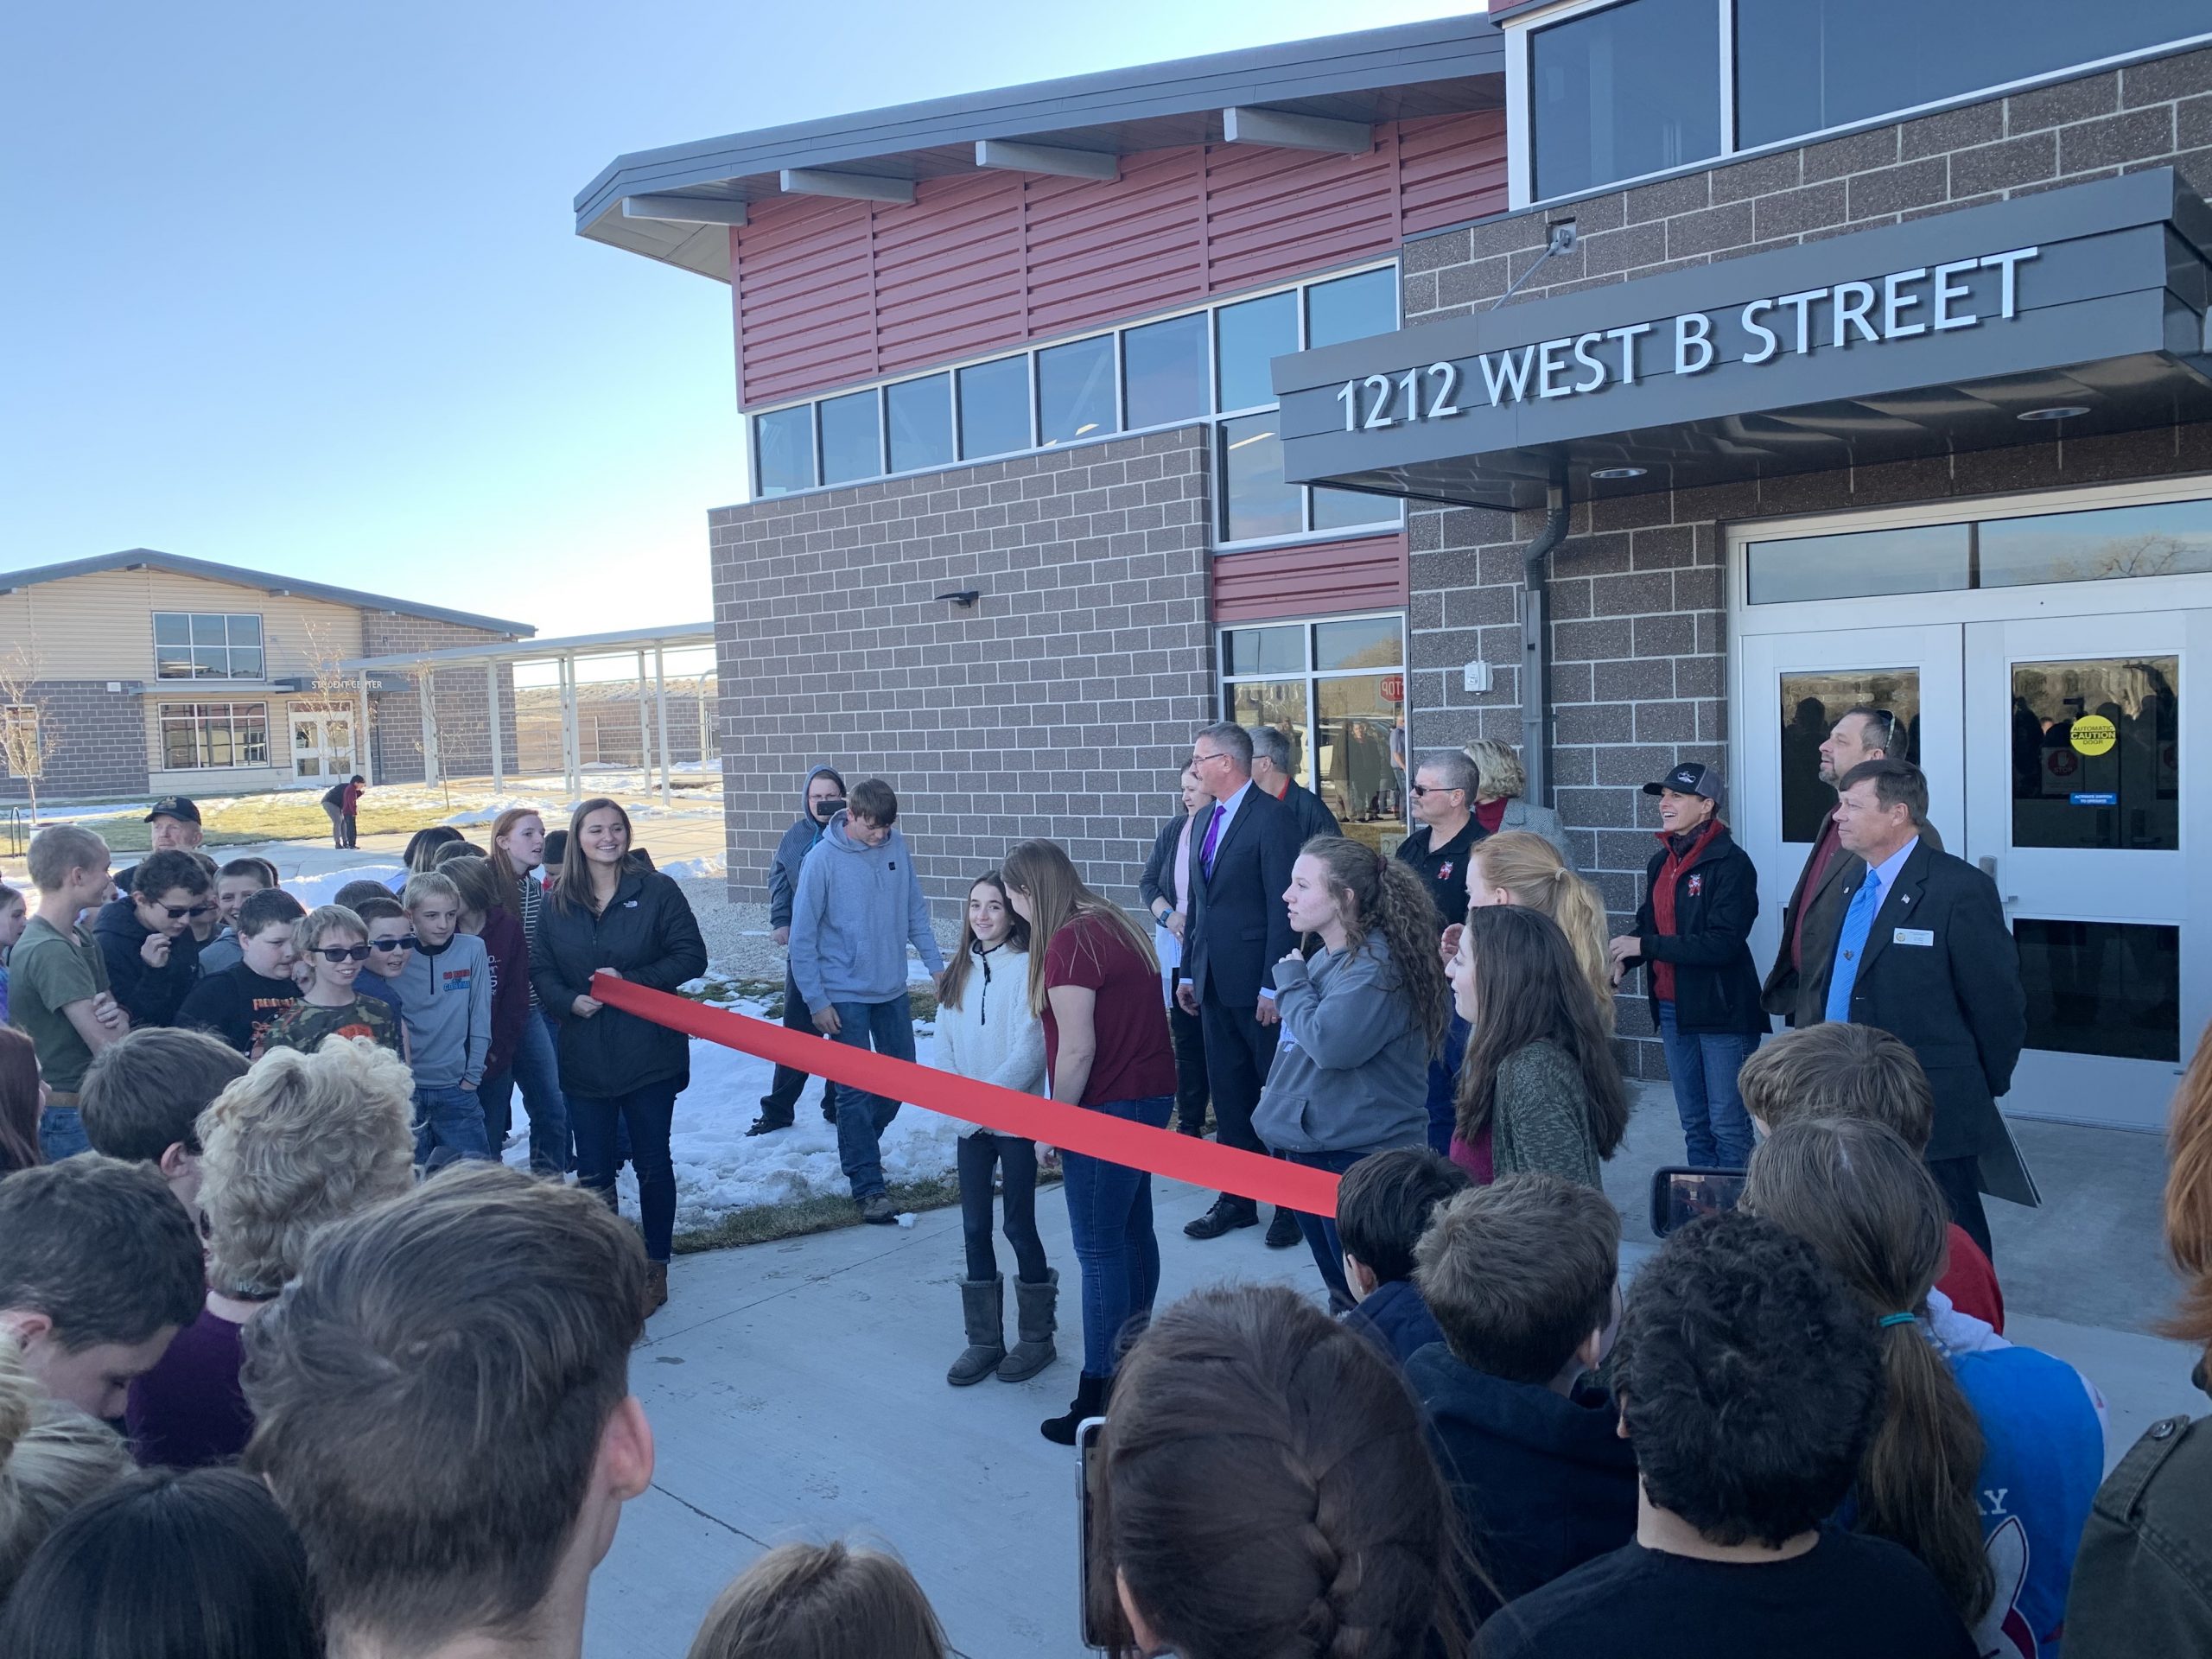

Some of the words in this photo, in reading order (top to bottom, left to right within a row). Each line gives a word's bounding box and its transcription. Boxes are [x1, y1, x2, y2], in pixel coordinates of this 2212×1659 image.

[1338, 361, 1458, 432] 1212
[1479, 323, 1651, 407] WEST
[1675, 313, 1715, 374] B
[1741, 247, 2038, 364] STREET
